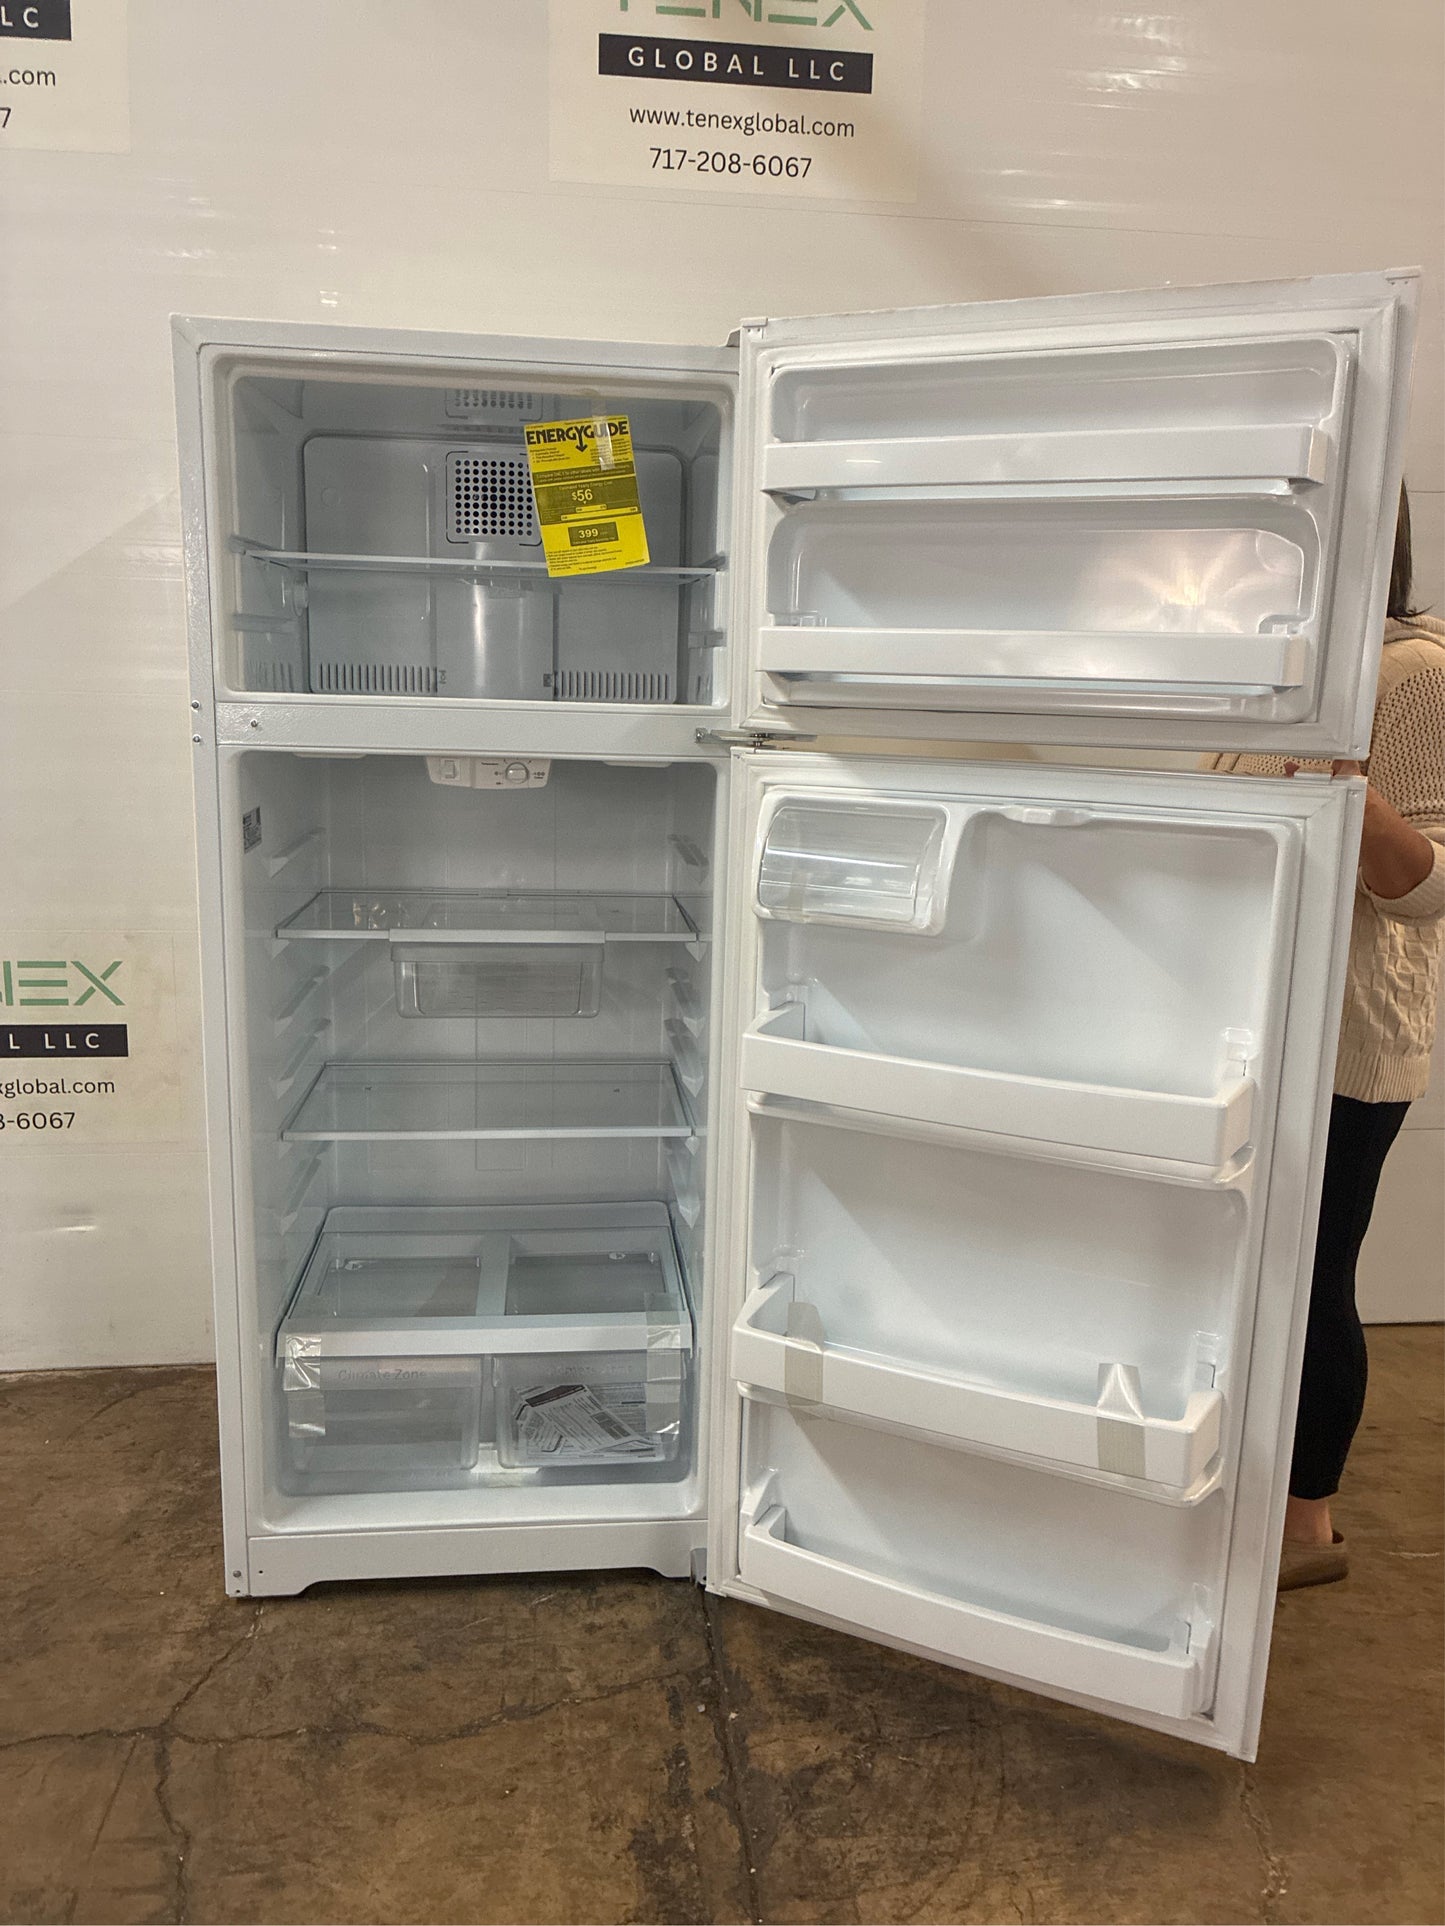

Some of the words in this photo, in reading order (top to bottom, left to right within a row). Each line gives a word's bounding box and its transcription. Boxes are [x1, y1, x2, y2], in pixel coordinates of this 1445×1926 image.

[627, 46, 765, 76] GLOBAL
[788, 57, 845, 82] LLC
[629, 106, 855, 138] www.tenexglobal.com
[648, 147, 812, 178] 717-208-6067
[571, 488, 593, 502] $56
[578, 528, 599, 539] 399
[44, 1032, 100, 1050] LLC
